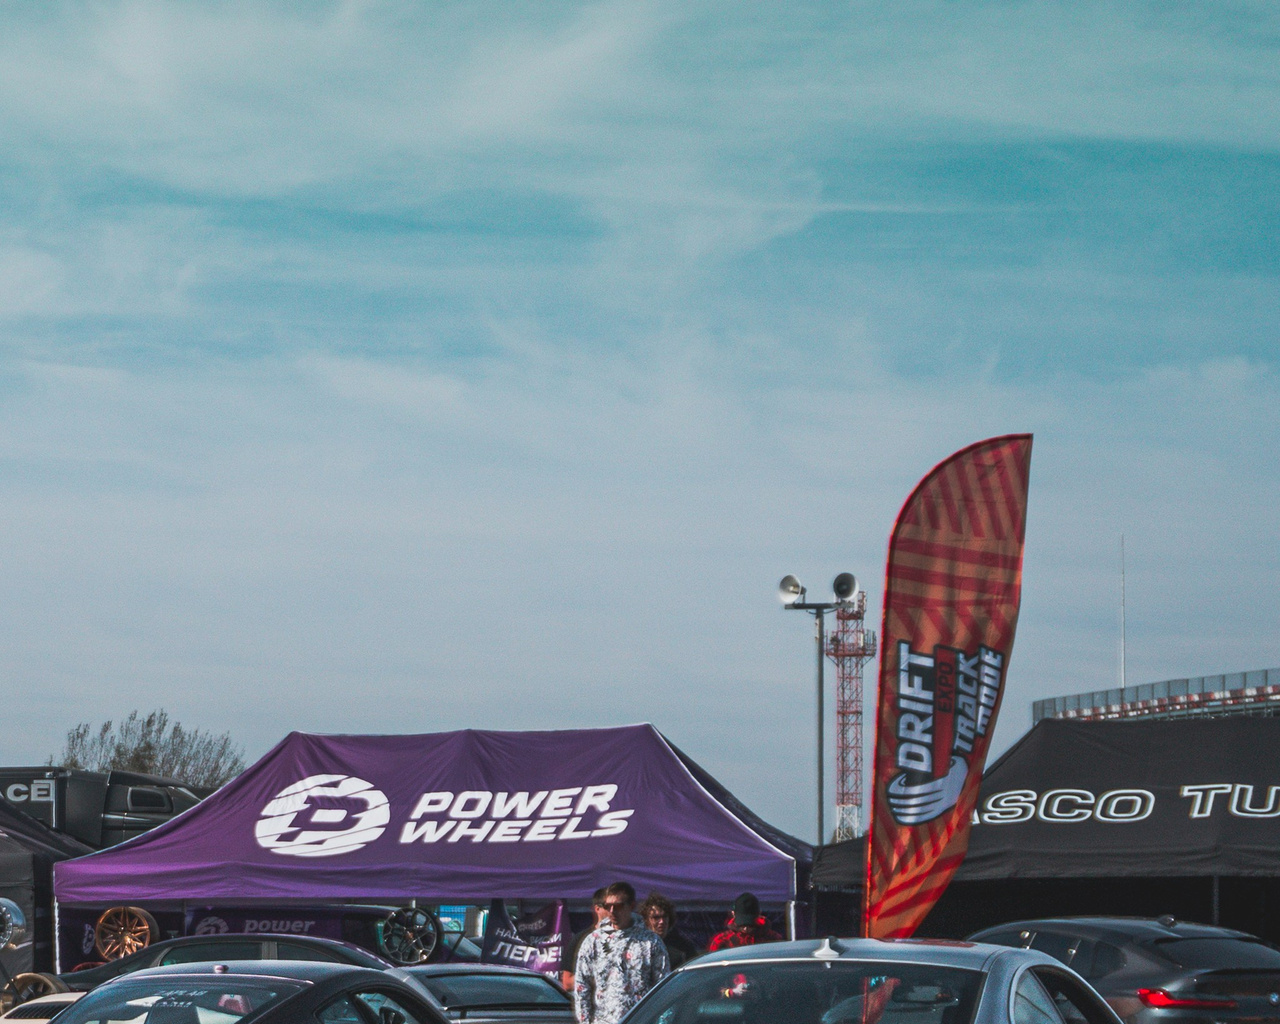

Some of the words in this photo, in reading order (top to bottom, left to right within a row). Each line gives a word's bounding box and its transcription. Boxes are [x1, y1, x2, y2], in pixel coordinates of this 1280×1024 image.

[898, 642, 934, 772] DRIFT
[937, 660, 954, 713] EXPO
[954, 652, 979, 752] TRACK
[977, 647, 1003, 735] MODE
[410, 783, 619, 819] POWER
[972, 788, 1156, 825] SCO
[1180, 783, 1280, 818] TU
[399, 809, 635, 844] WHEELS
[244, 919, 316, 933] power
